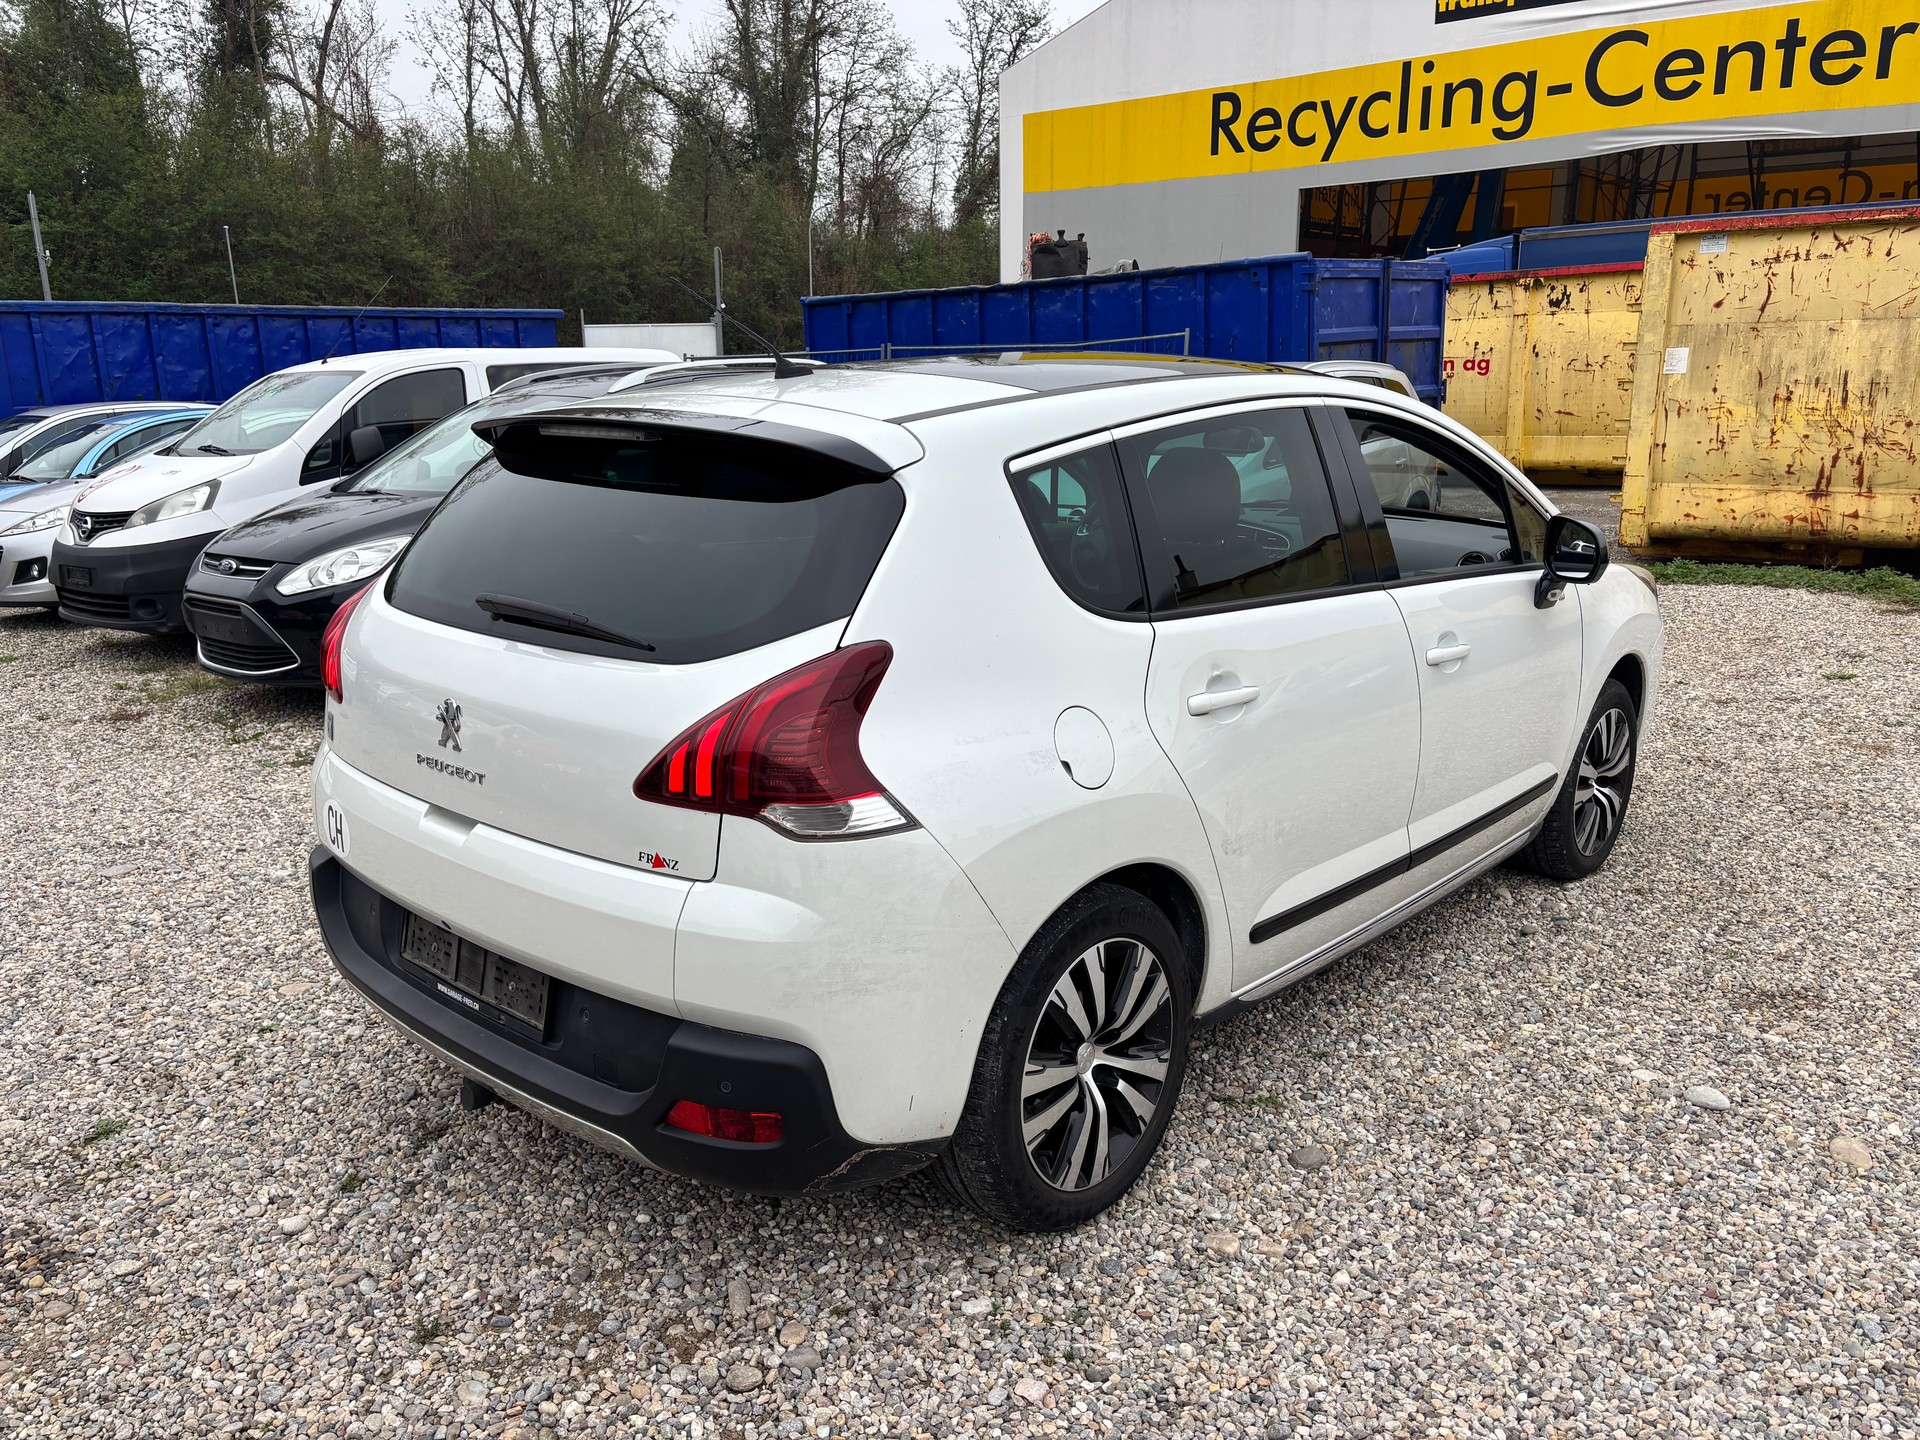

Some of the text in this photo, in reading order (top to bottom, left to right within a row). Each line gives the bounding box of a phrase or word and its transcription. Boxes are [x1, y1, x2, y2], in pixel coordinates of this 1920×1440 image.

[1210, 17, 1920, 162] Recycling-Center
[1462, 358, 1491, 376] ag
[416, 751, 486, 786] PEUGEOT
[327, 804, 345, 853] CH
[638, 851, 679, 871] FRANZ
